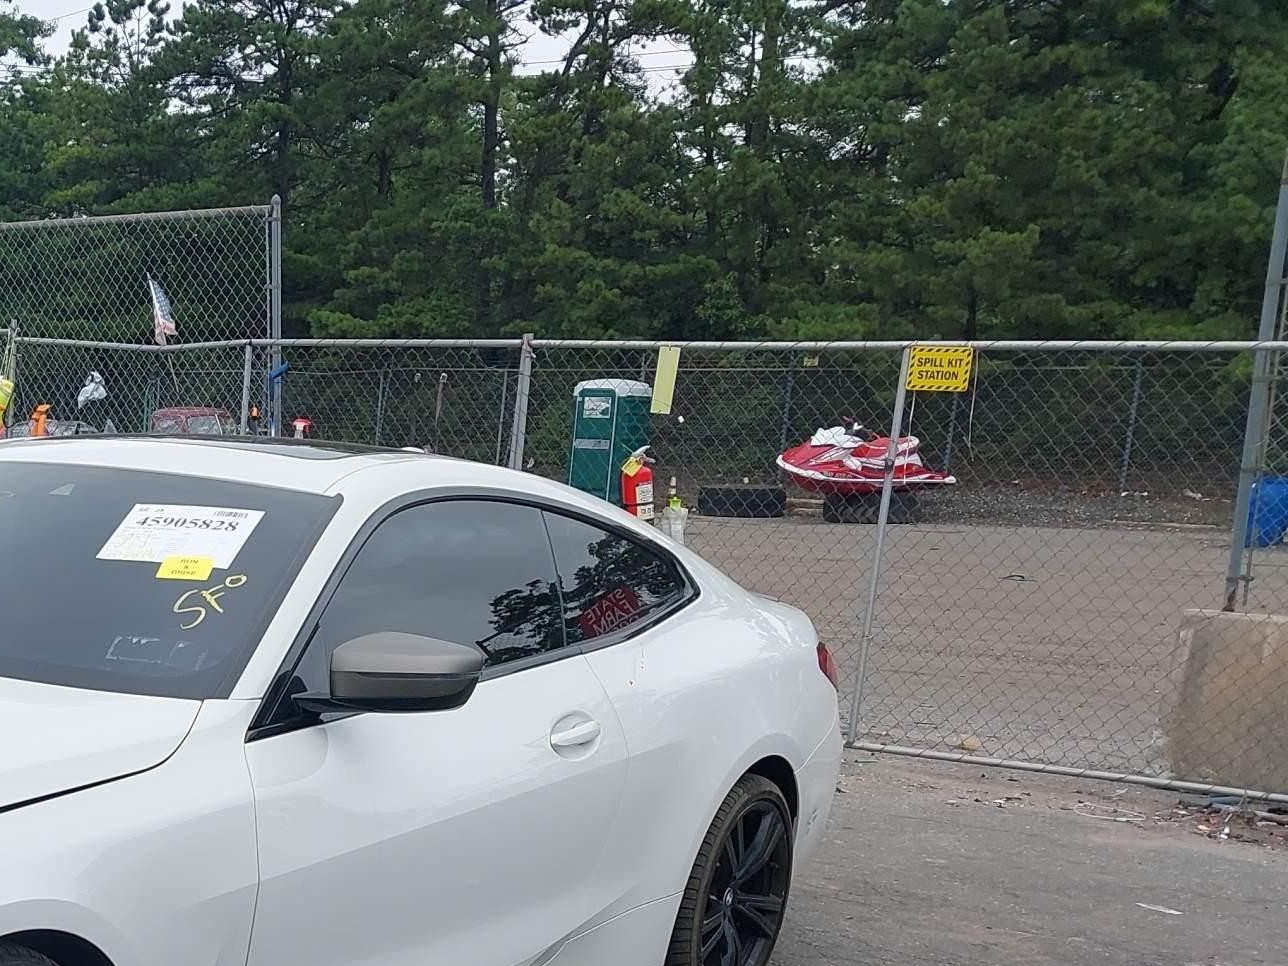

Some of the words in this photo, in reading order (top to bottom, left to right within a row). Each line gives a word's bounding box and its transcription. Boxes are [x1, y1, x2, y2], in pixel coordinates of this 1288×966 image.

[916, 357, 945, 368] SPILL
[947, 357, 964, 369] KIT
[916, 369, 960, 381] STATION
[135, 515, 240, 533] 45905828
